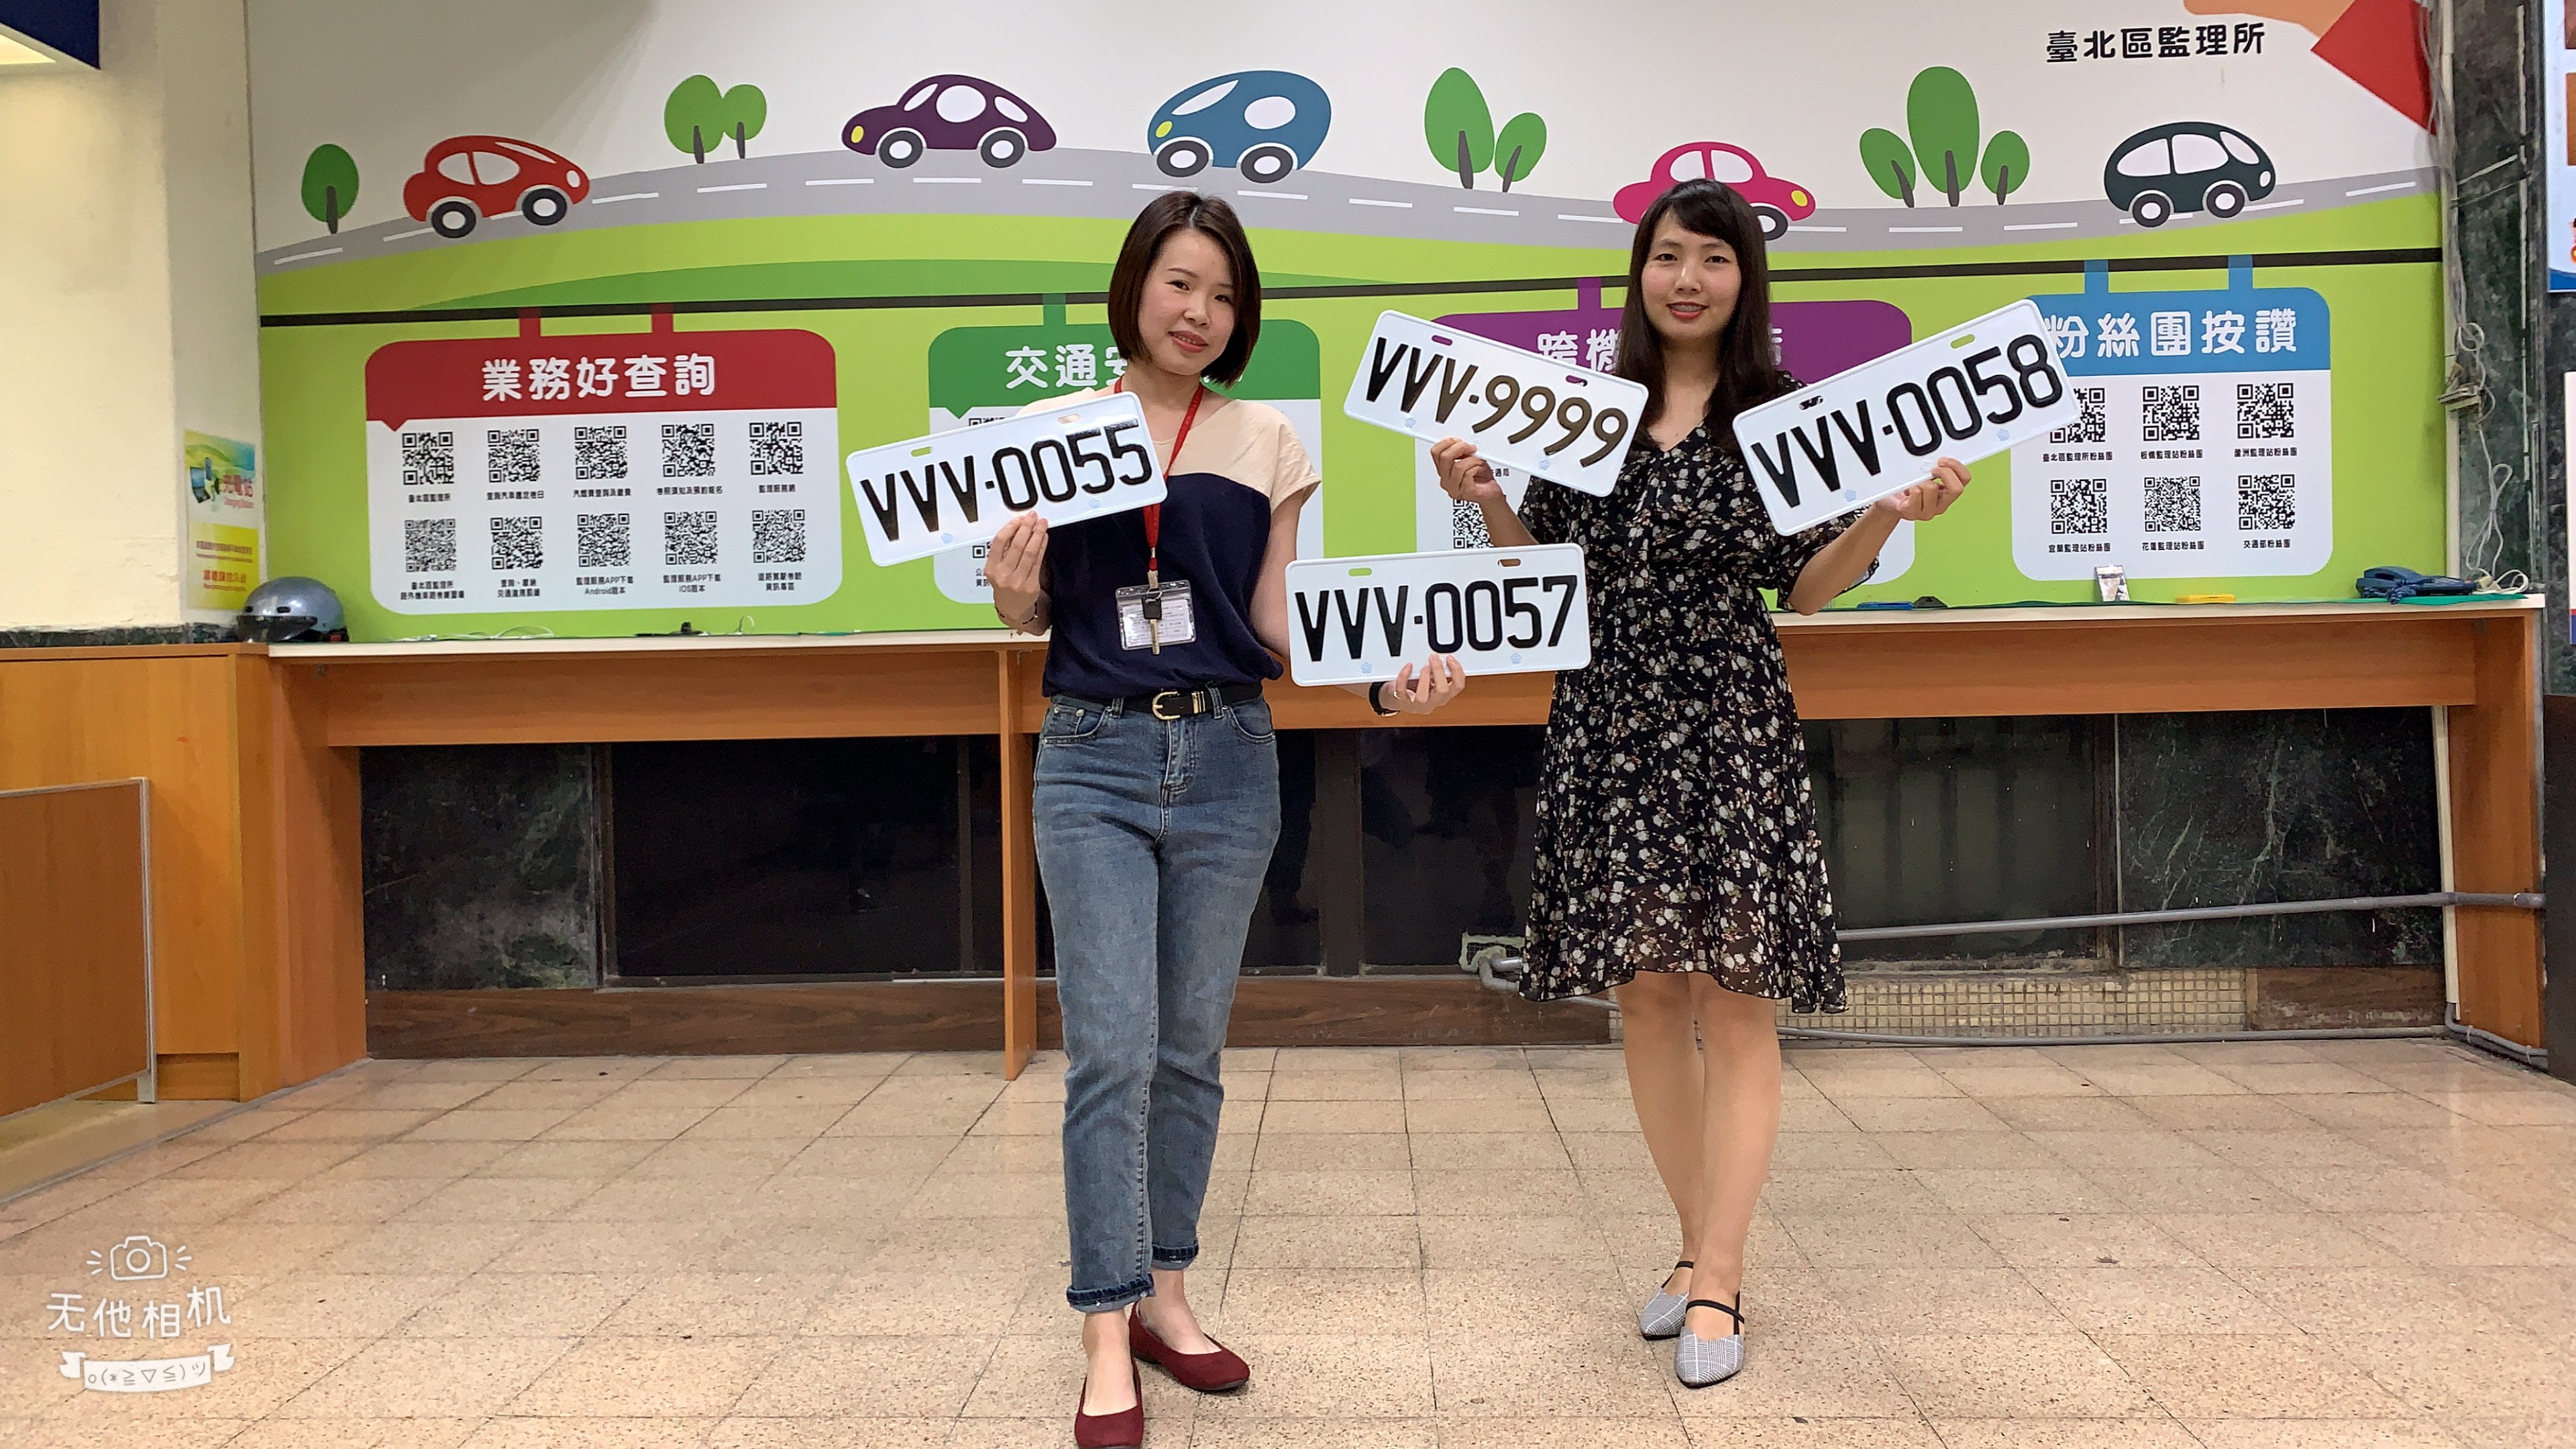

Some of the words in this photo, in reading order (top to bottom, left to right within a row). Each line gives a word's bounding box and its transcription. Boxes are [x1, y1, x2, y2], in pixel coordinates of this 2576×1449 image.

[2046, 22, 2265, 63] 臺北區監理所
[2044, 307, 2297, 358] 粉絲團按讚
[482, 353, 715, 402] 業務好查詢
[2043, 451, 2113, 462] 臺北區監理所粉絲團
[2141, 449, 2203, 460] 板橋監理站粉絲團
[2049, 543, 2111, 553] 宜蘭監理站粉絲團
[2142, 541, 2204, 551] 花蓮監理站粉絲團
[2243, 539, 2291, 549] 交通部粉絲團
